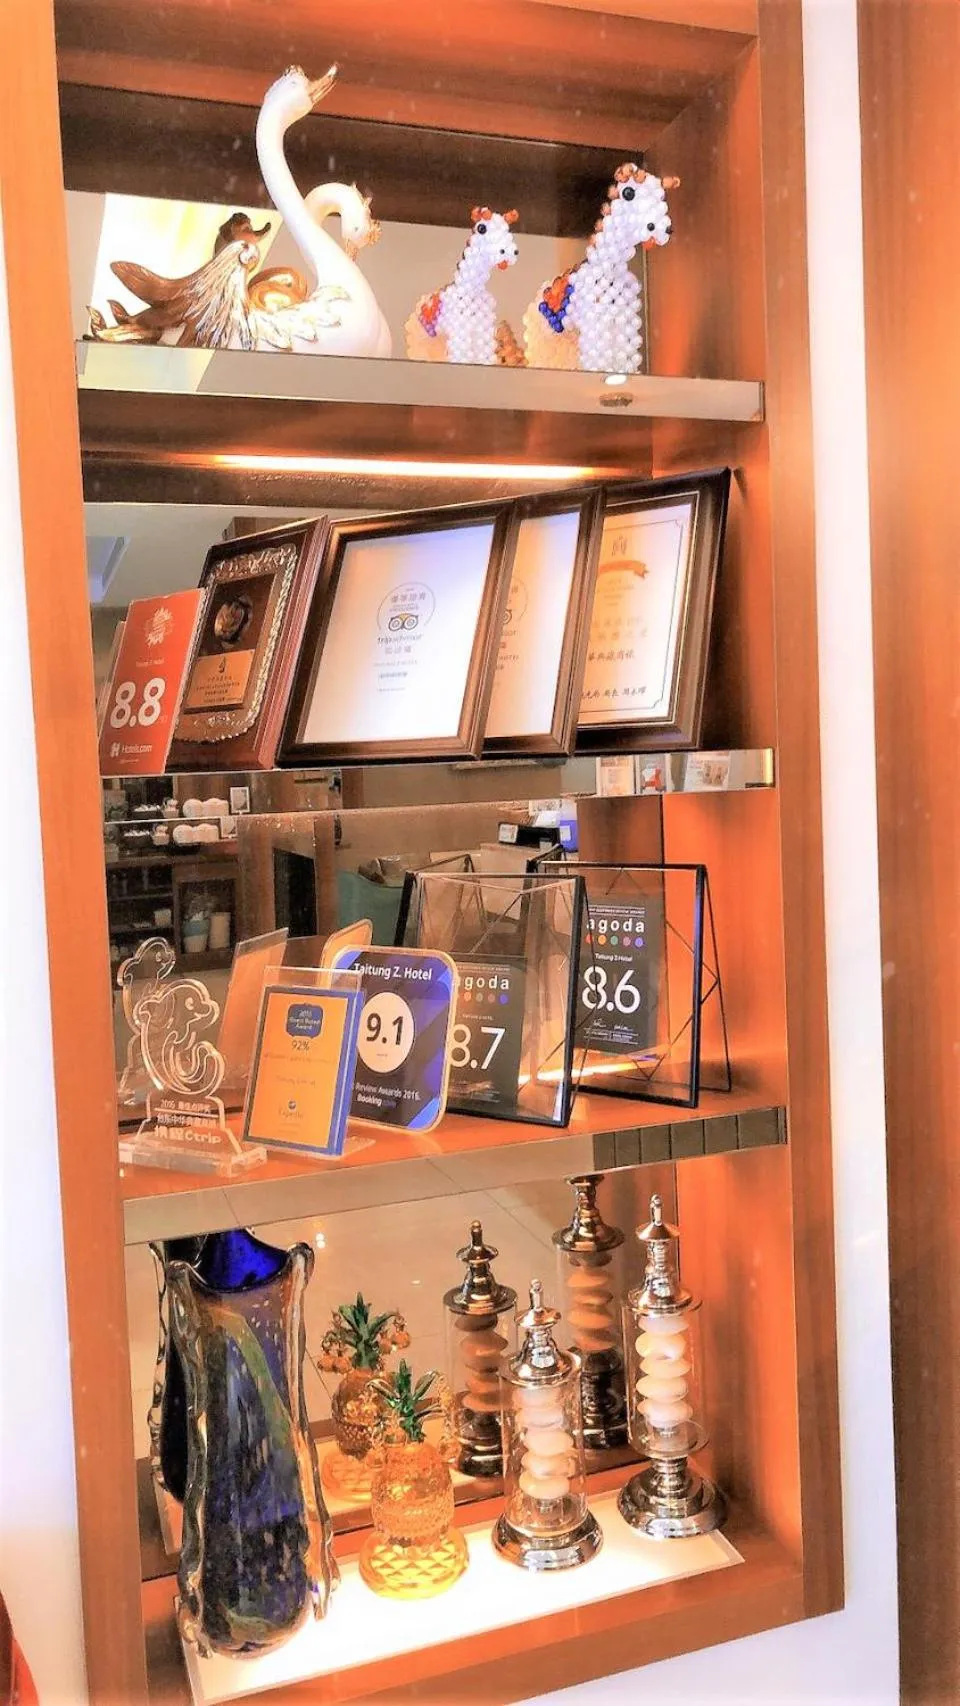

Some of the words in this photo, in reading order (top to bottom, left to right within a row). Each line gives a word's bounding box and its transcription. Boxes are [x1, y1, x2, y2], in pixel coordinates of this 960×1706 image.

[110, 677, 166, 729] 8.8
[586, 918, 645, 933] agoda
[353, 963, 391, 980] Taitung
[404, 968, 433, 981] Hotel
[581, 965, 641, 1014] 8.6
[365, 1012, 404, 1046] 9.1
[450, 1023, 506, 1070] 8.7
